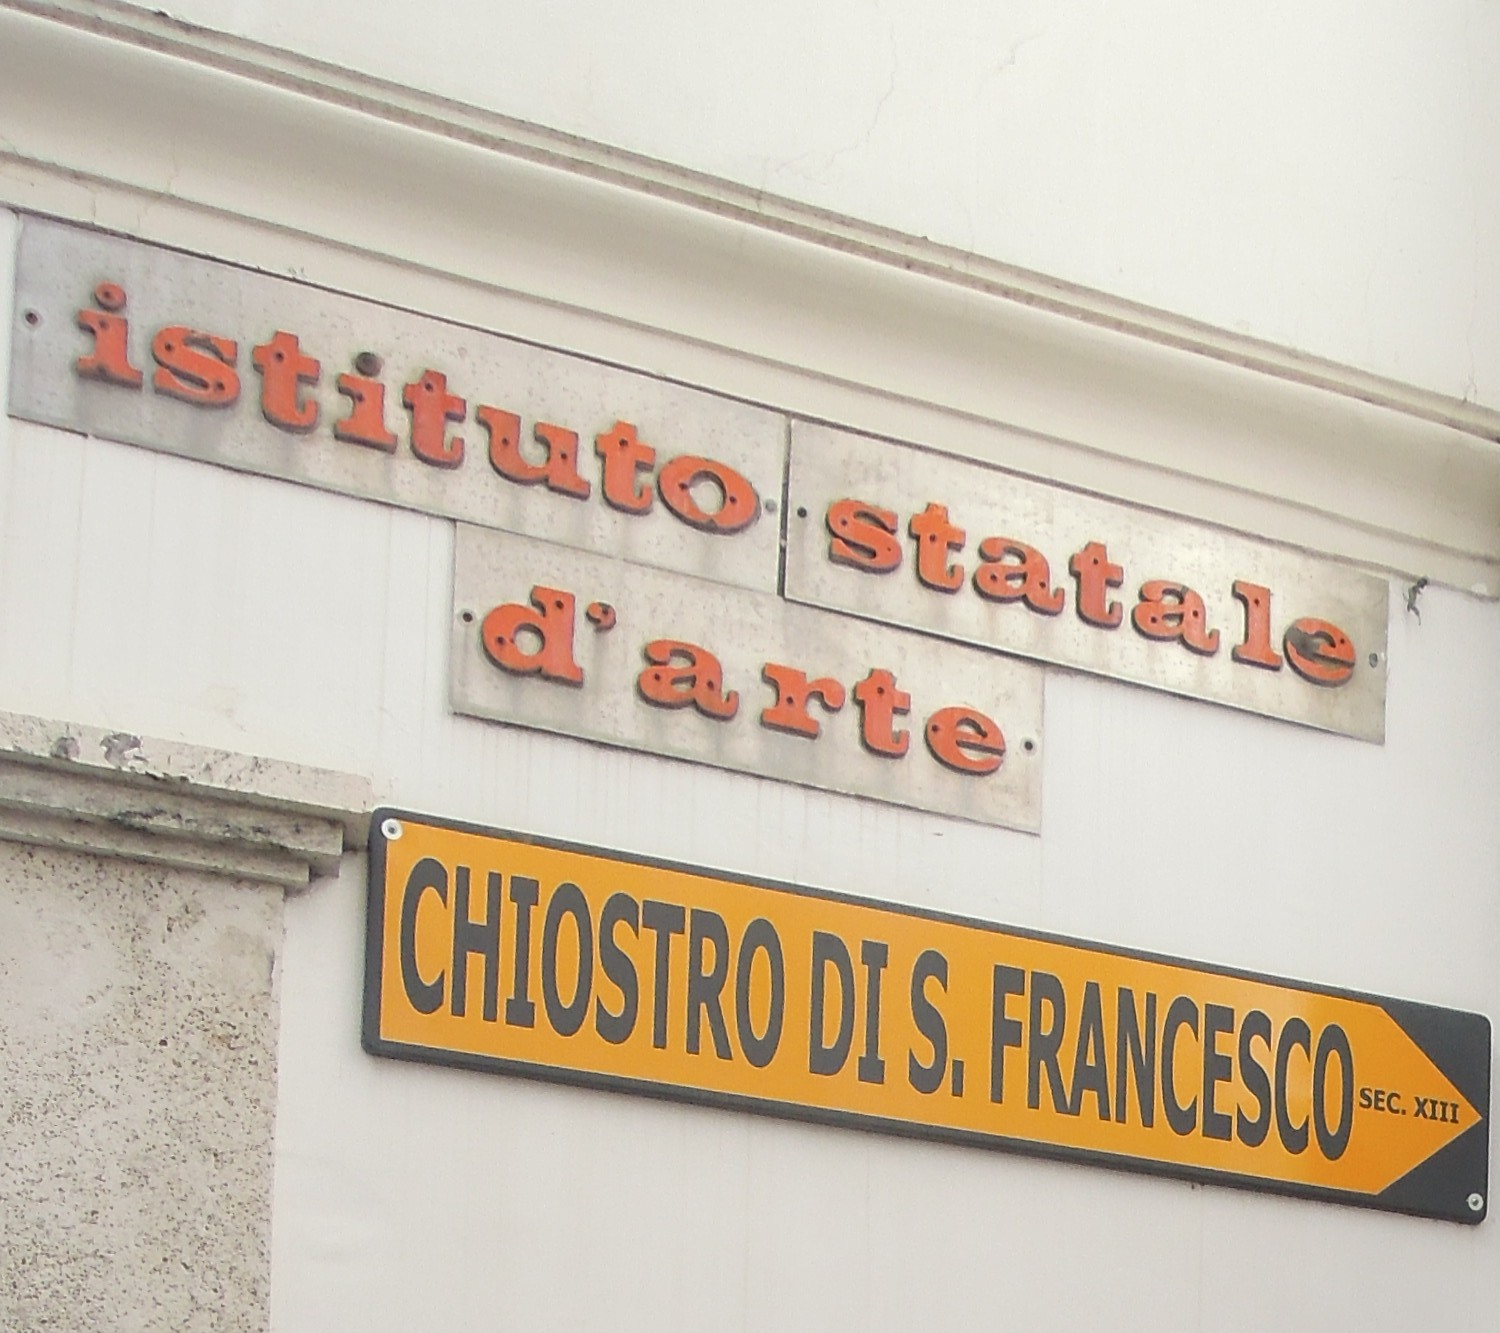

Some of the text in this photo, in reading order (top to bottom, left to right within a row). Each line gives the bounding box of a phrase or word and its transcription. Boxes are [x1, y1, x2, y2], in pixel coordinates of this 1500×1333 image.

[75, 282, 1357, 688] istituto statale
[482, 586, 1009, 775] d'arte
[400, 858, 1459, 1158] CHIOSTRO DI S. FRANCESCO SEC. XIII
